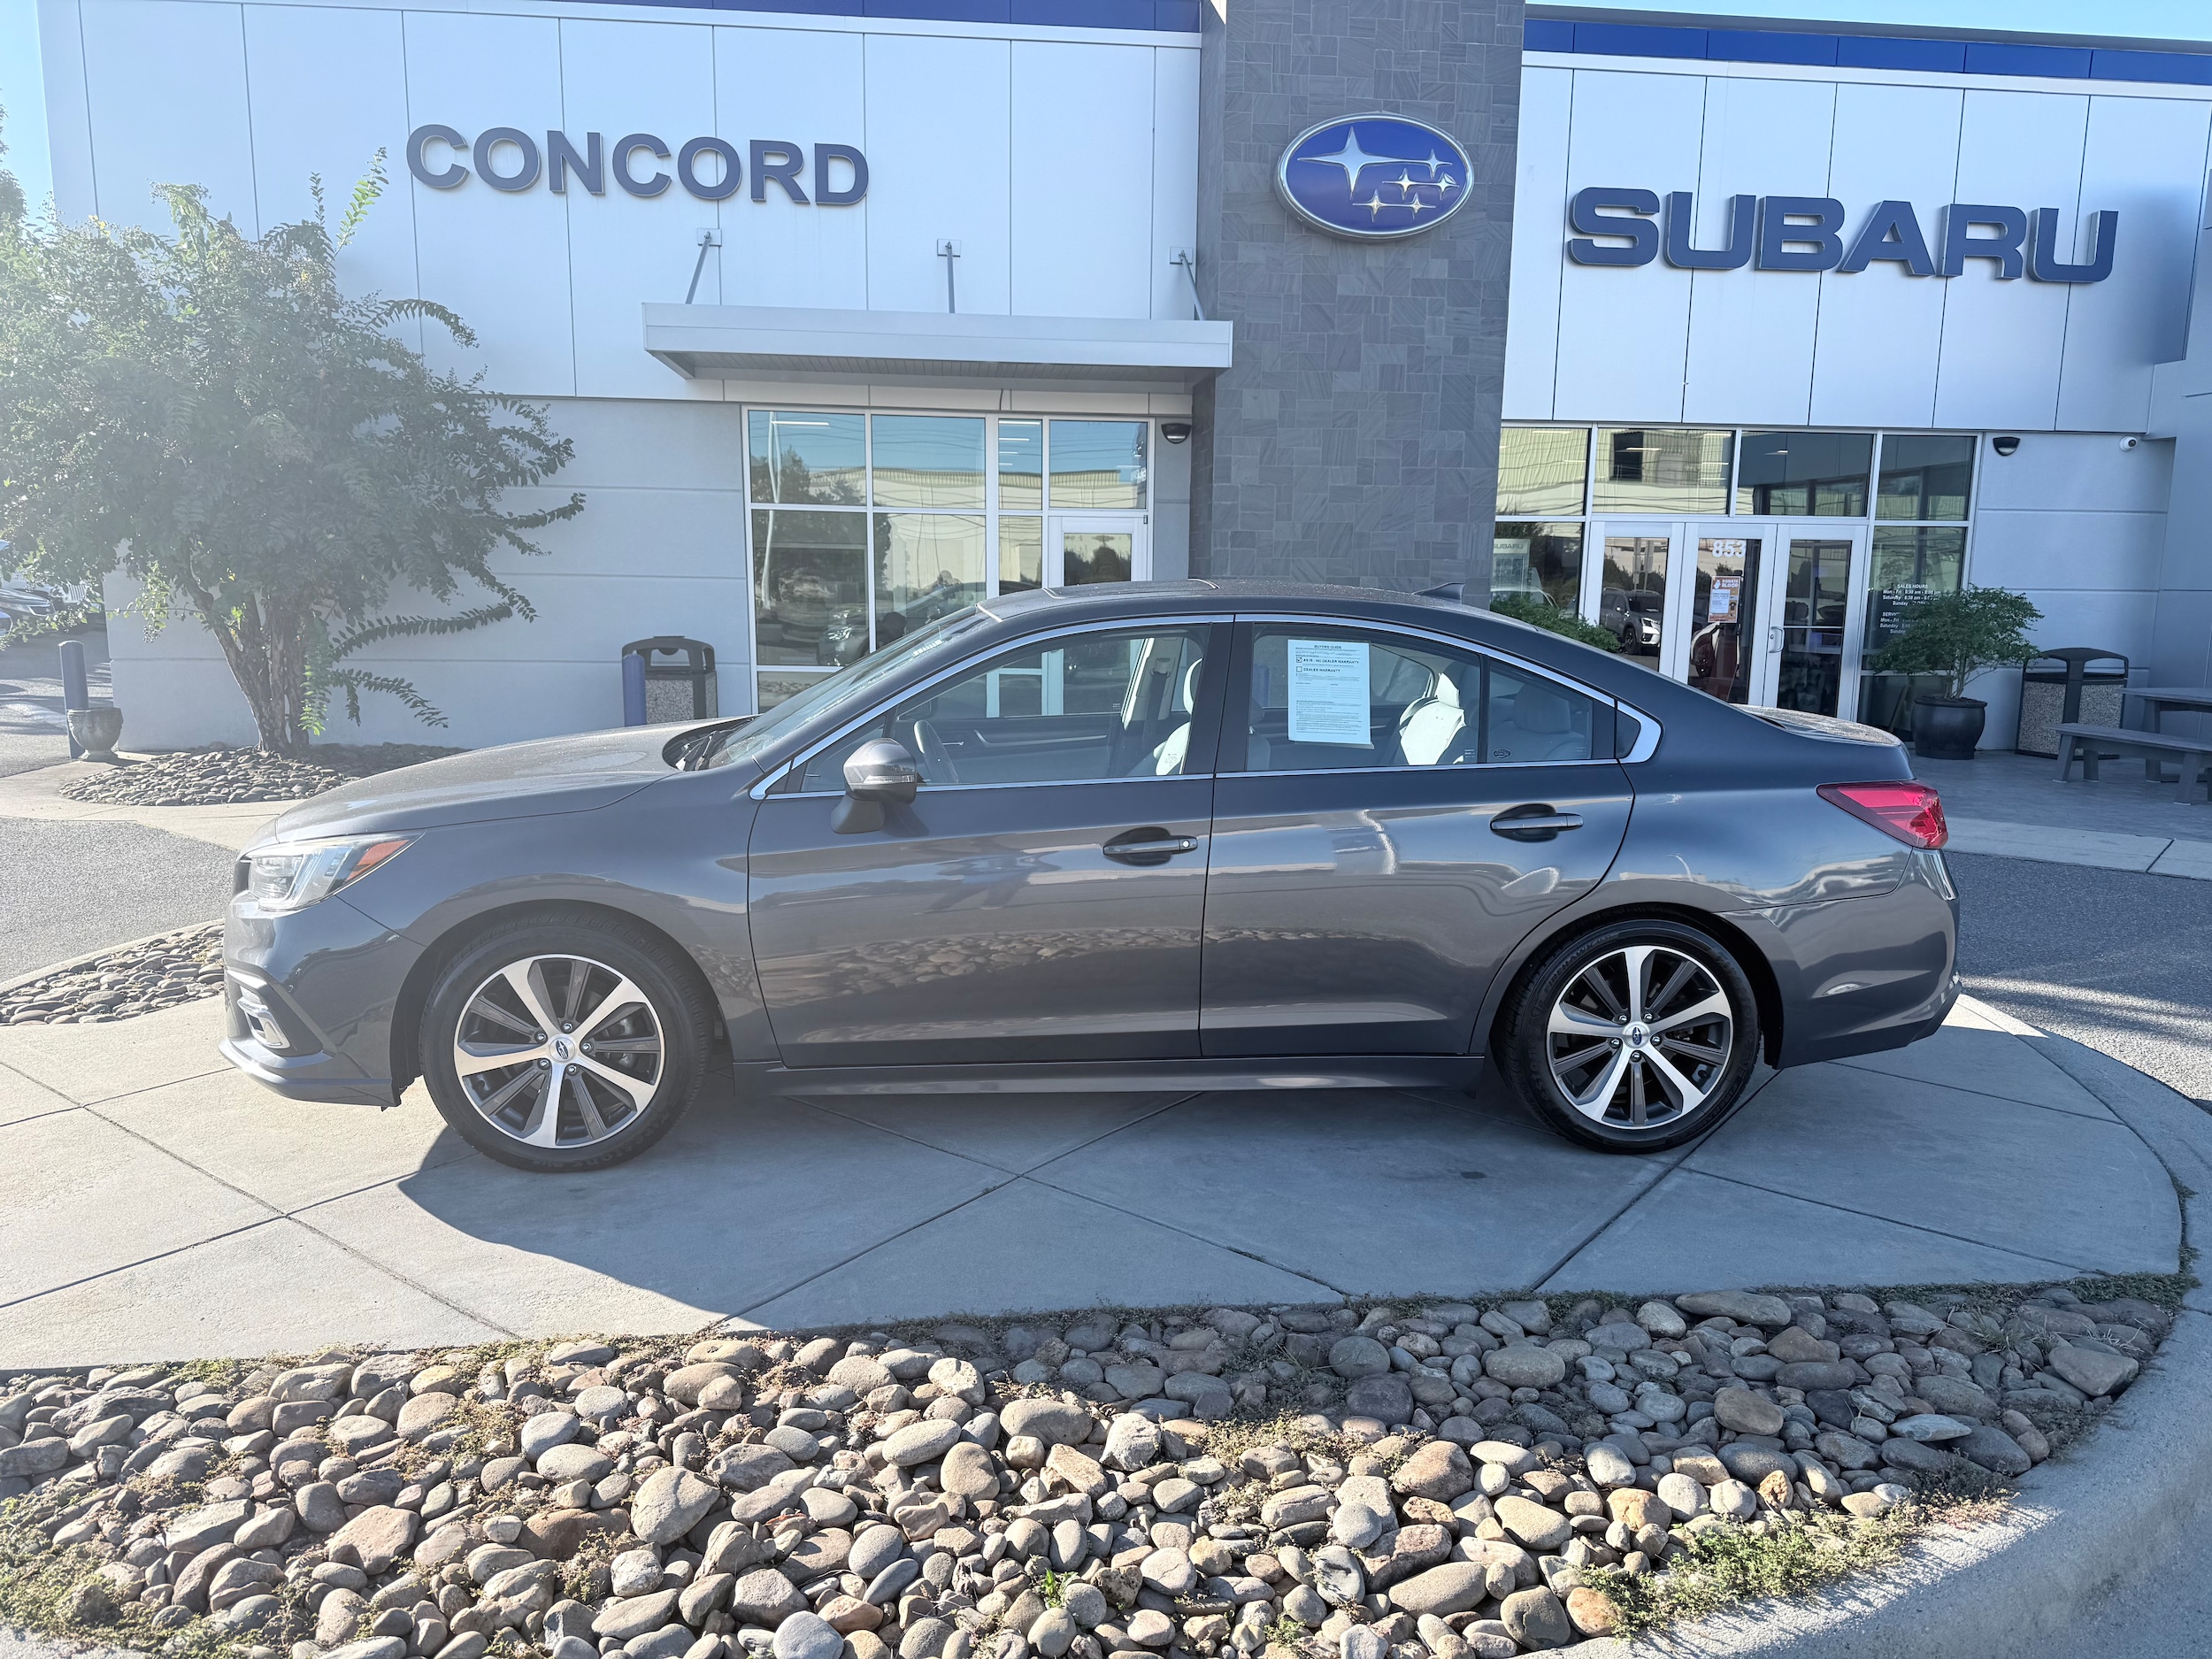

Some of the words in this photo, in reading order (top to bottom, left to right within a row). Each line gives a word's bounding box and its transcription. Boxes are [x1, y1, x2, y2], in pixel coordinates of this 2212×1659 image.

[406, 124, 870, 207] CONCORD
[1567, 187, 2119, 283] SUBARU
[1712, 540, 1747, 557] 853
